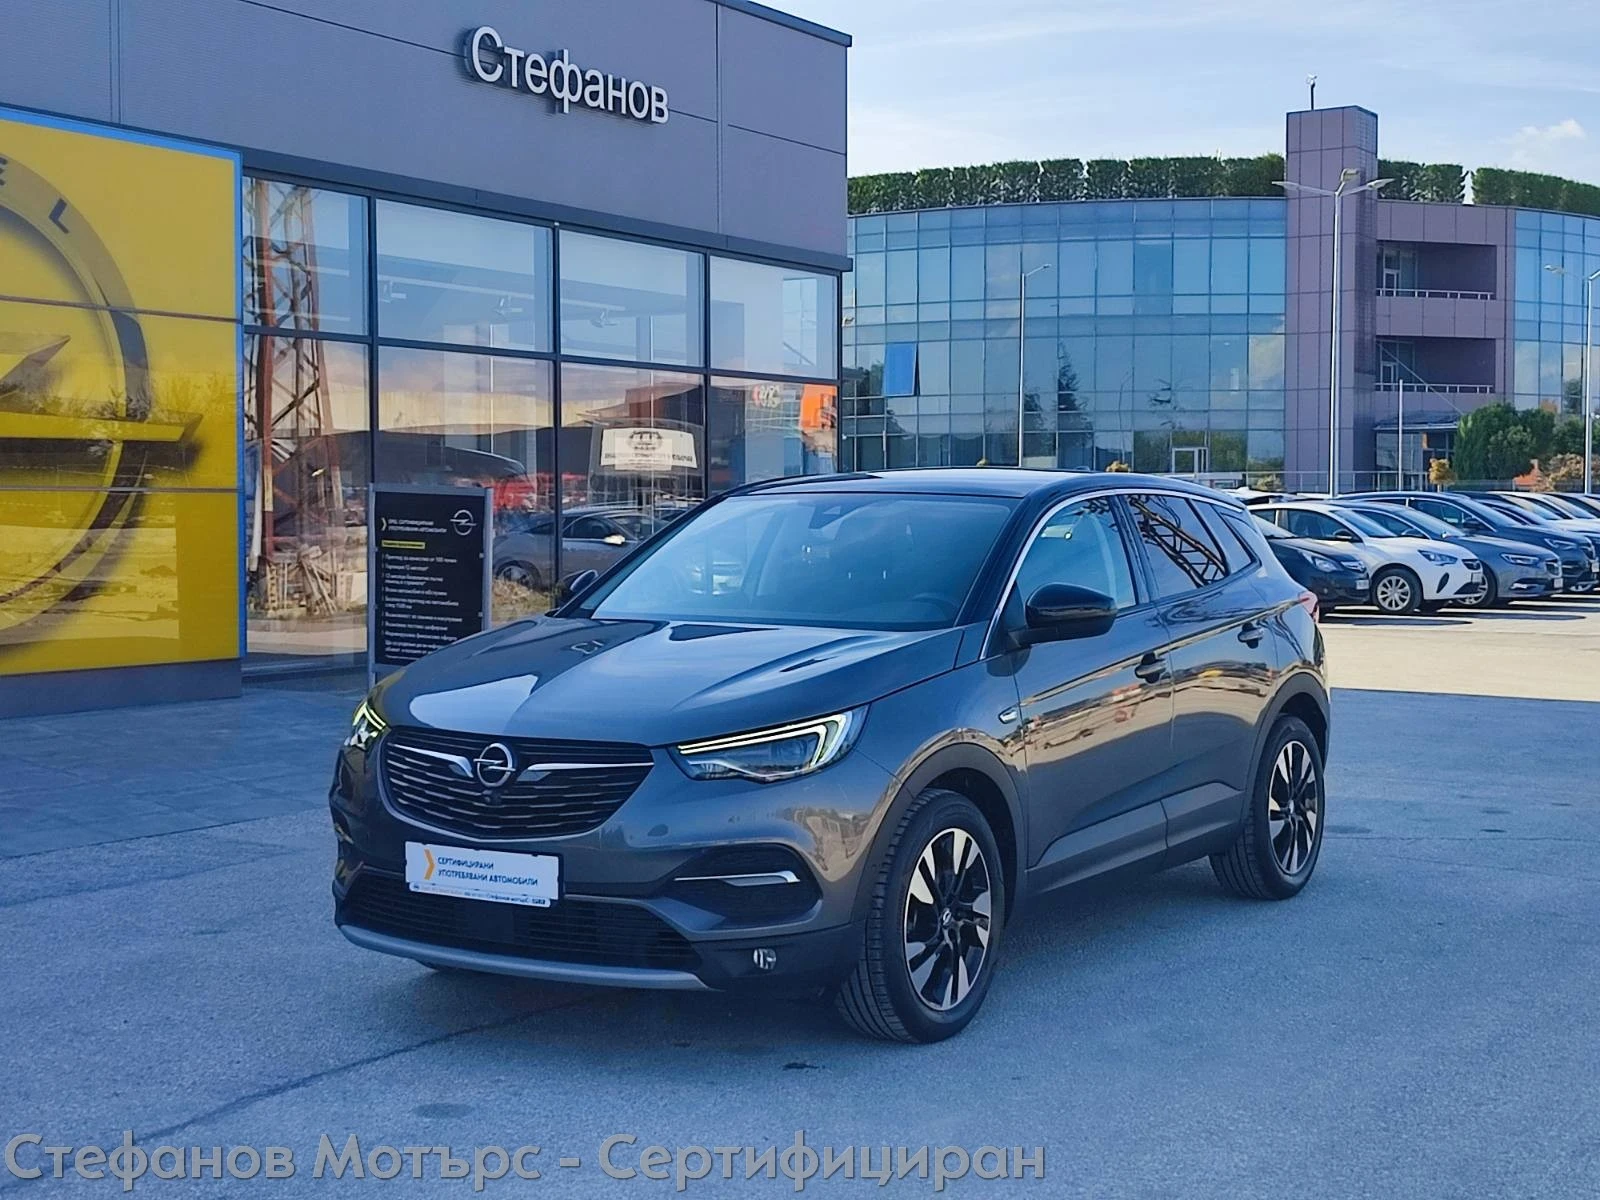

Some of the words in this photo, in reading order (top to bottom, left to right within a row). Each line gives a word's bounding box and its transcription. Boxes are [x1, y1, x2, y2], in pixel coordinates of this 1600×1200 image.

[469, 25, 669, 124] Стефанов
[437, 856, 494, 870] СЕРТИФИЦИРАНИ
[438, 868, 488, 881] УПОТРЕБЯВАНИ
[489, 874, 538, 886] АВТОМОБИЛИ
